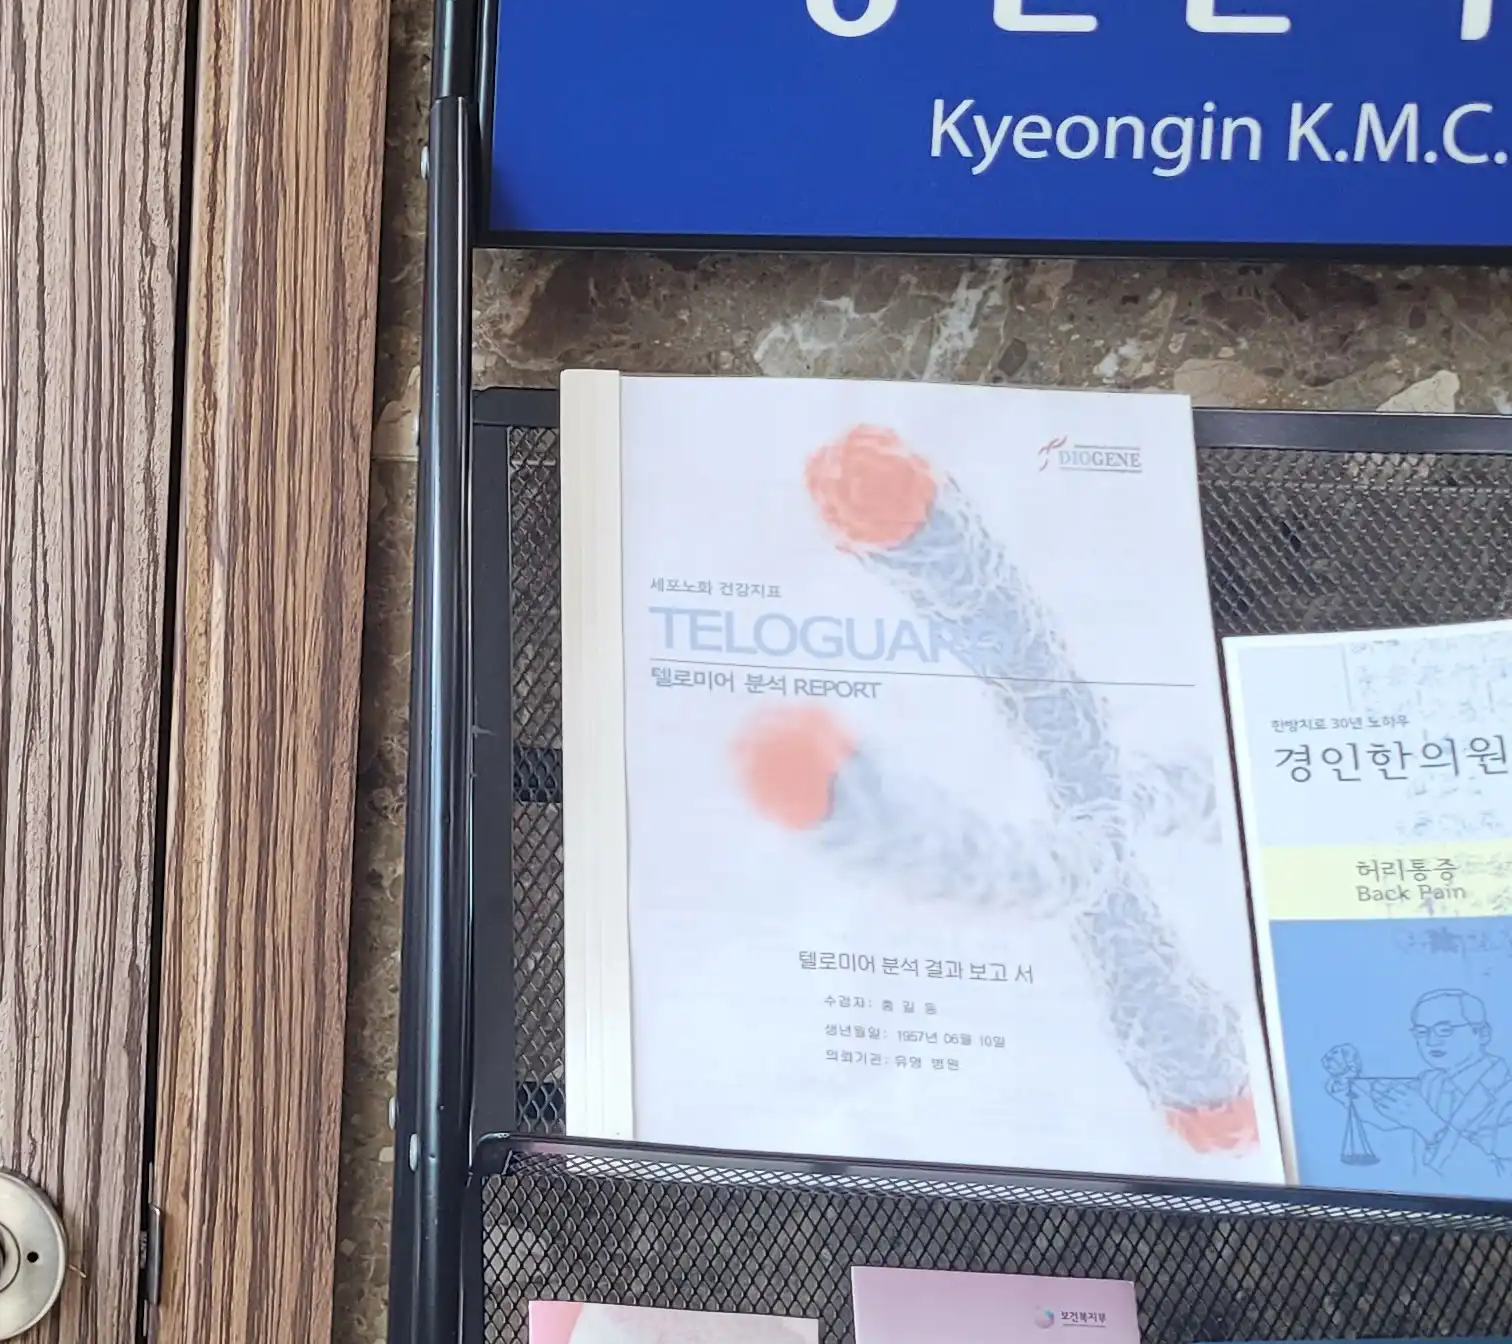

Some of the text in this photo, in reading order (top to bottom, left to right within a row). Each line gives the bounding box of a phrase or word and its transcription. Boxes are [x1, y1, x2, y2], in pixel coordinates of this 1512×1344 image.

[929, 98, 1509, 178] Kyeongin K.M.C.
[1057, 450, 1143, 468] DIOGENE
[650, 577, 783, 599] 세포노화 건강지표
[651, 666, 883, 700] 텔로미어 분석 REPORT
[1331, 716, 1363, 731] 30년
[1274, 734, 1510, 783] 경인한의원
[1355, 858, 1459, 883] 허리통증
[1356, 884, 1467, 902] Back Pain
[798, 950, 876, 973] 텔로미어
[881, 956, 919, 977] 분석
[925, 958, 964, 980] 결과
